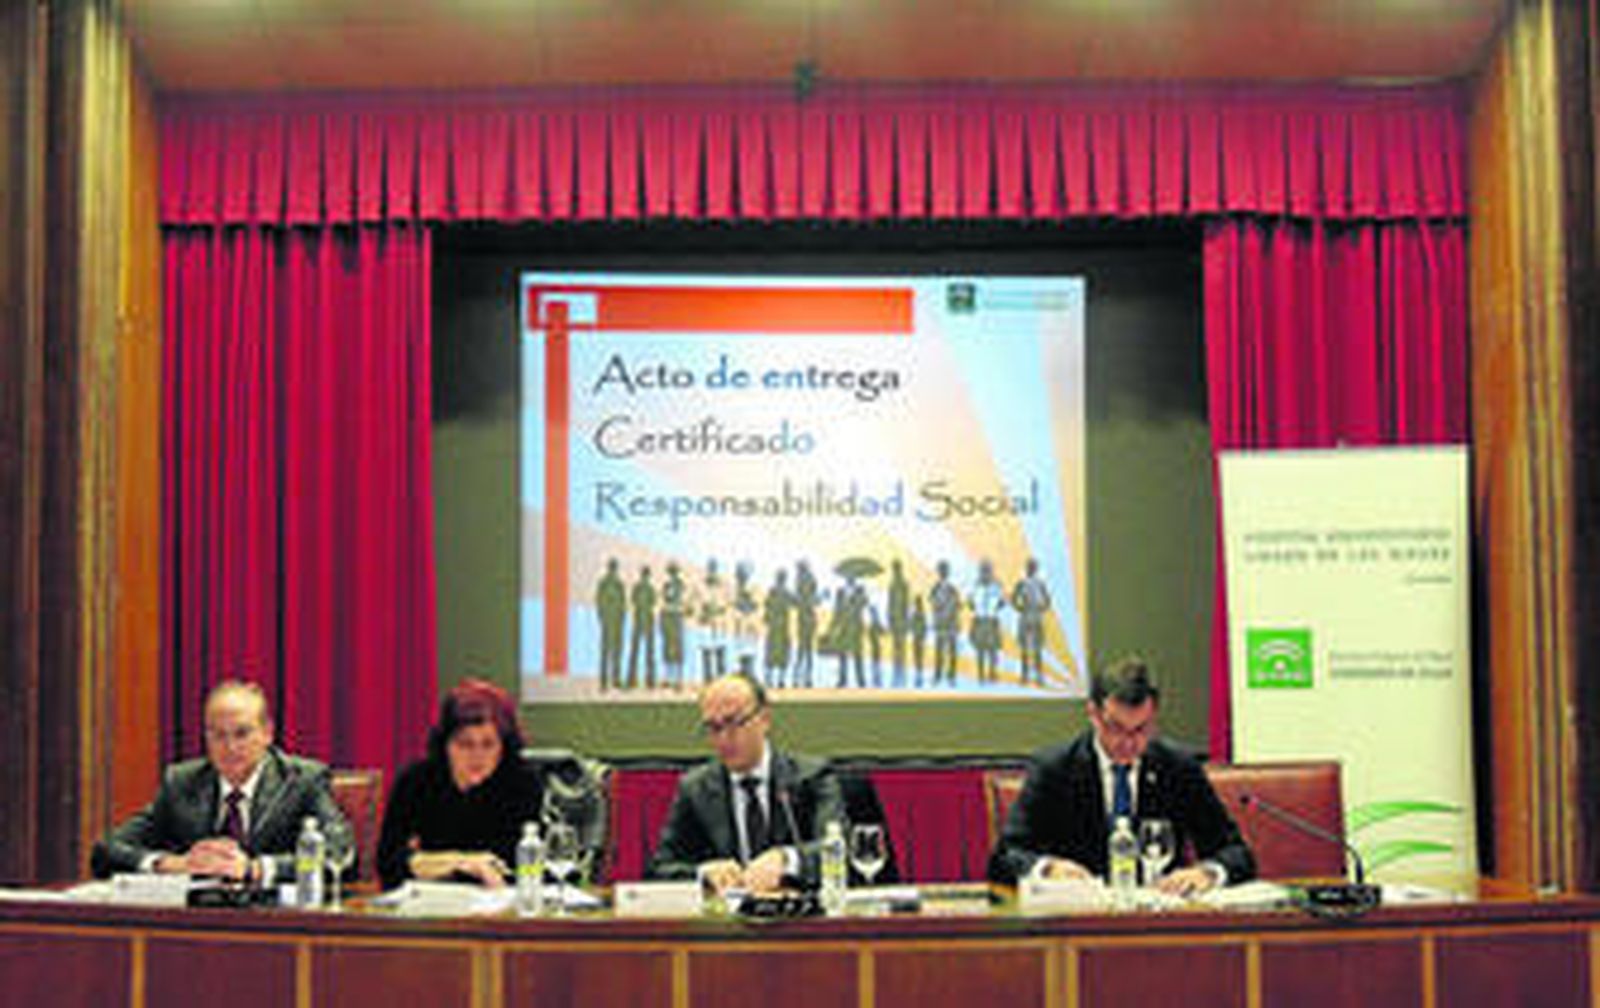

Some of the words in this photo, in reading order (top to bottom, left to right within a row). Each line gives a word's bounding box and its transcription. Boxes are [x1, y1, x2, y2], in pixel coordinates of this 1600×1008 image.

[593, 354, 695, 396] Acto
[705, 354, 750, 390] de
[761, 365, 900, 402] entrega
[593, 415, 815, 459] Certificado
[594, 477, 904, 531] Responsabilidad
[915, 478, 1039, 522] Social
